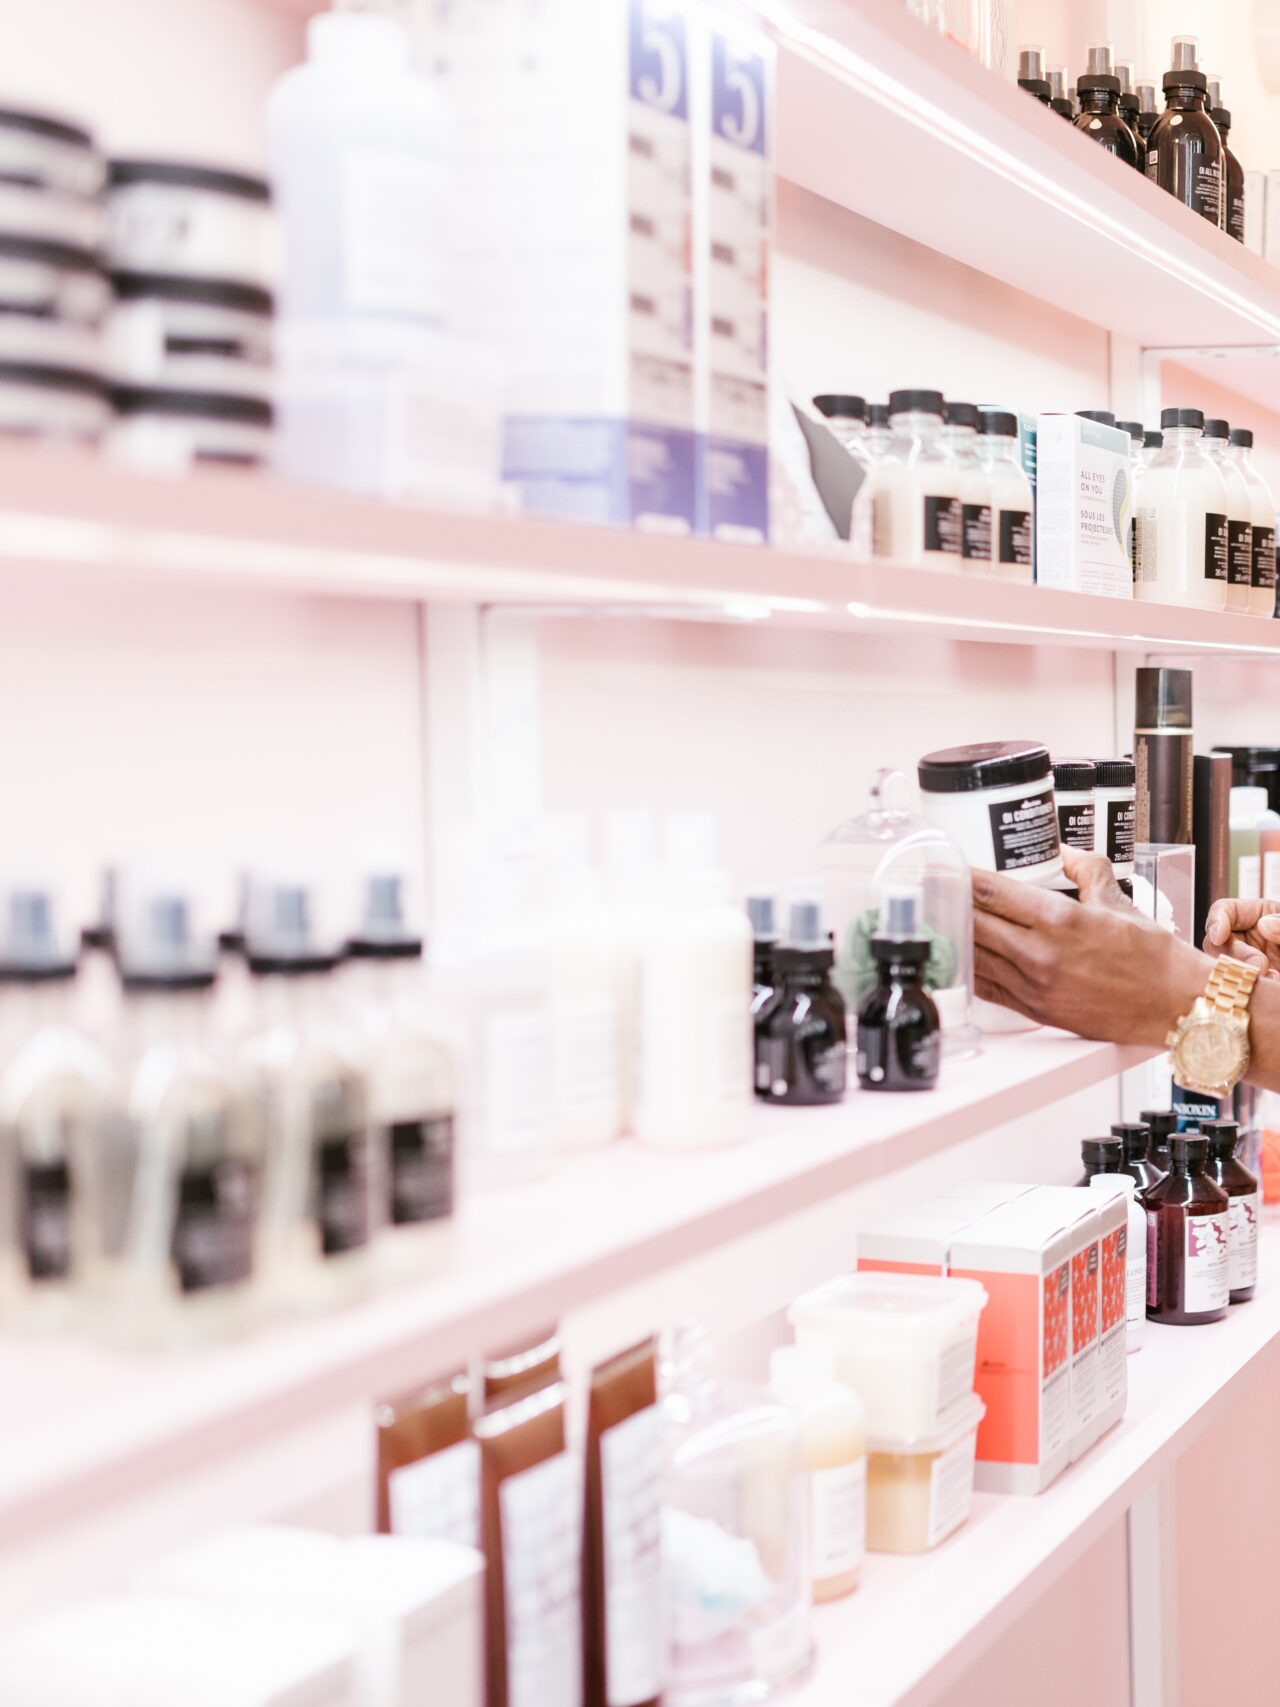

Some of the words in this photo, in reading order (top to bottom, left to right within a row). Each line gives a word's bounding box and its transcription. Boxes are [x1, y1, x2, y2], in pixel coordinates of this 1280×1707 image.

[719, 38, 760, 147] 5
[1080, 470, 1092, 481] ALL
[1092, 472, 1106, 483] EYES
[1080, 482, 1090, 493] ON
[1091, 484, 1103, 496] YOU
[1069, 816, 1076, 826] OI
